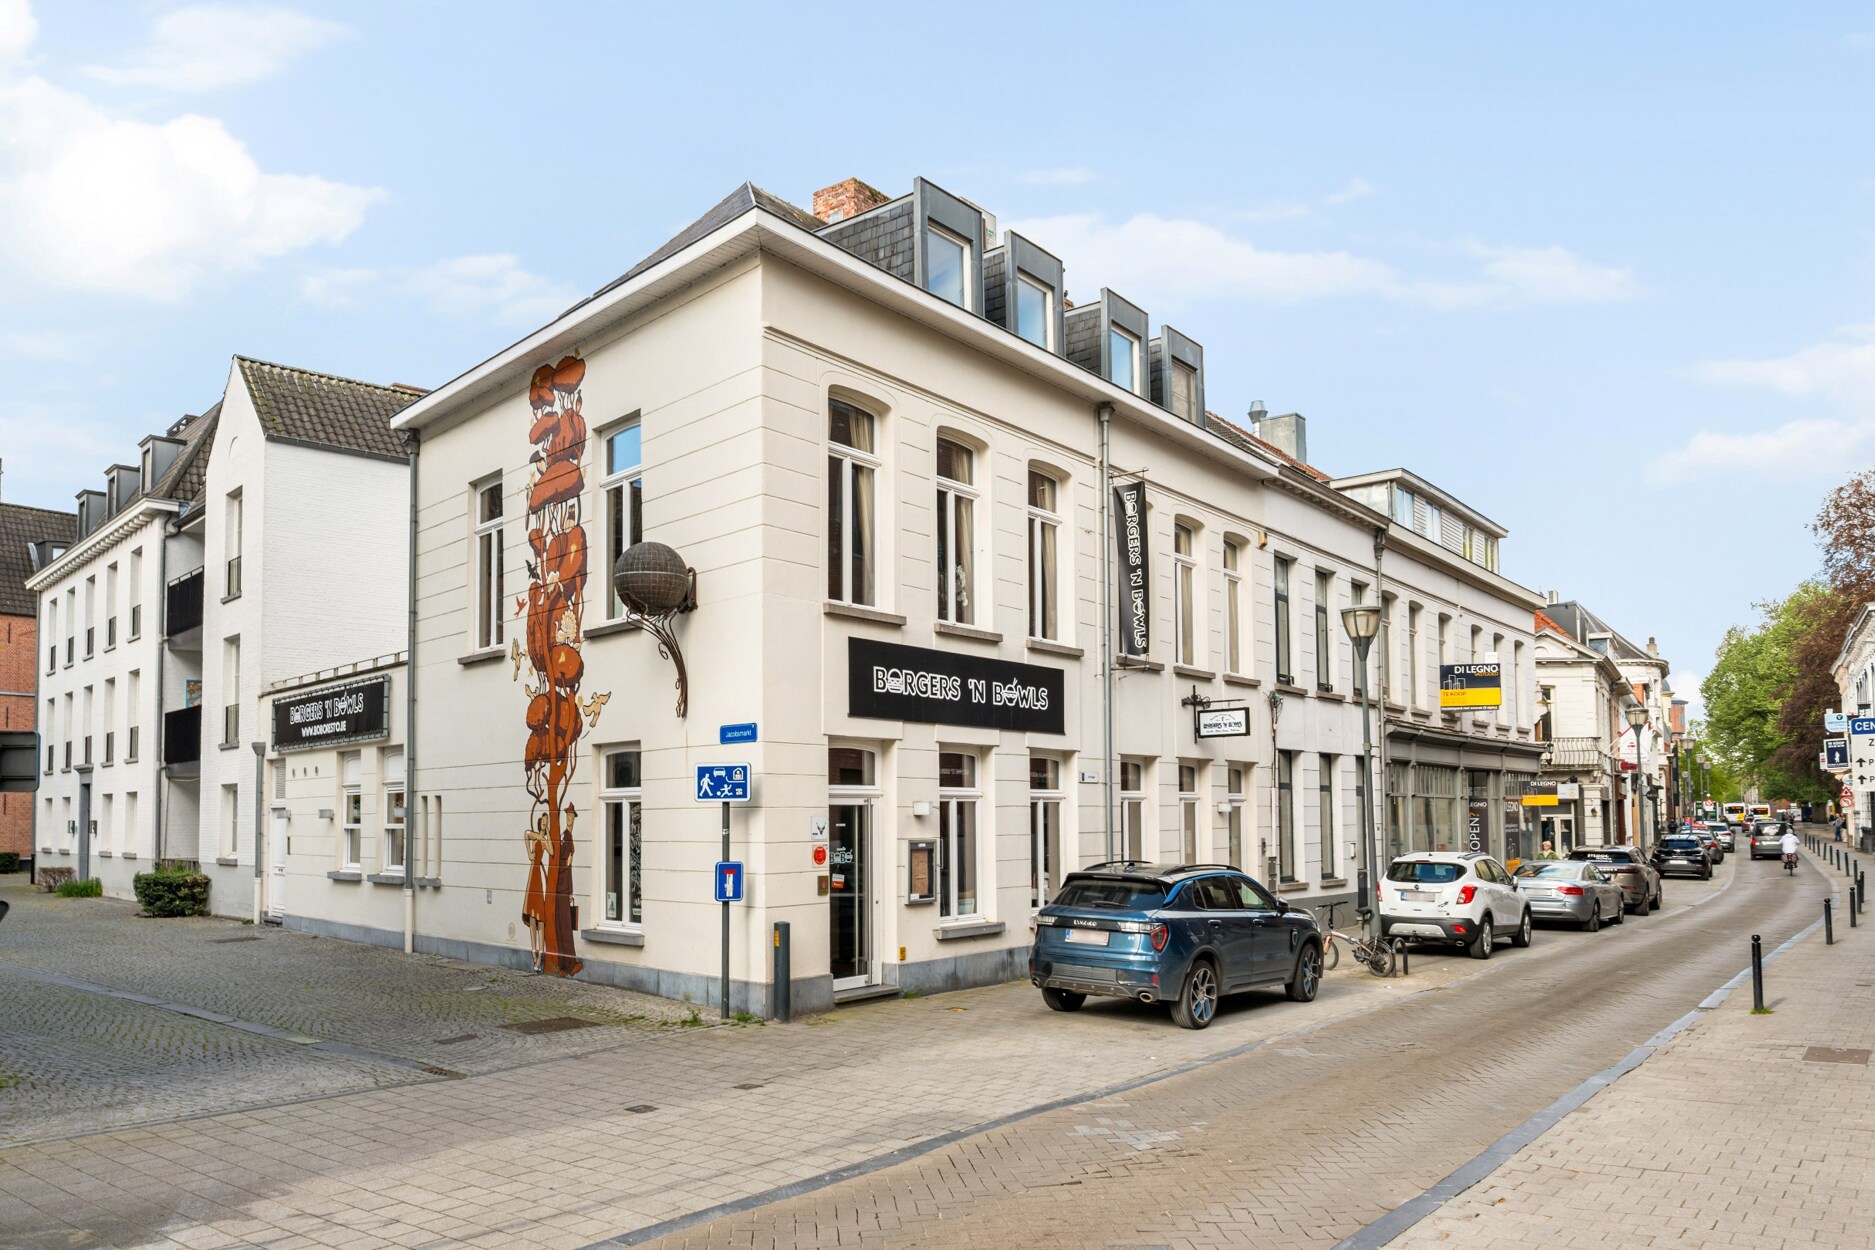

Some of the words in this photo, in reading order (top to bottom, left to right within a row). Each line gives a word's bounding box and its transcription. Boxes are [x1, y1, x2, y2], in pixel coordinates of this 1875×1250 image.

[1131, 589, 1147, 648] BOWLS
[1454, 666, 1465, 674] DI
[1466, 665, 1499, 673] LEGNO
[334, 692, 363, 716] BOWLS
[992, 677, 1049, 710] BOWLS
